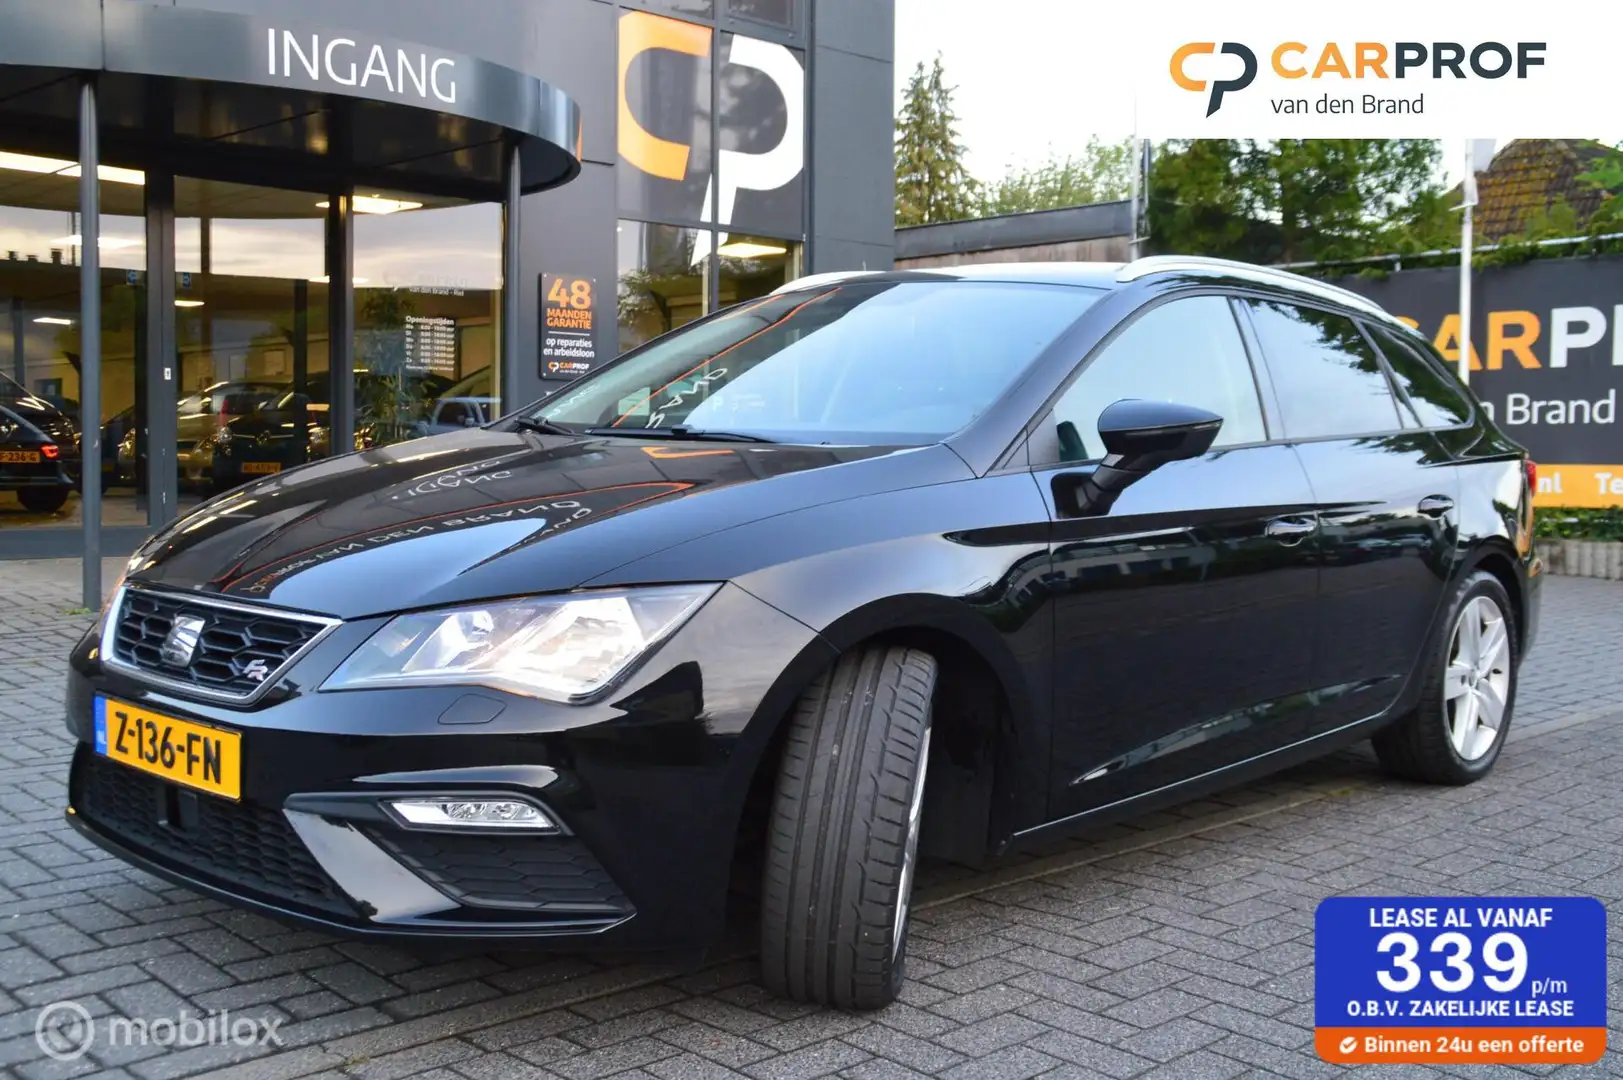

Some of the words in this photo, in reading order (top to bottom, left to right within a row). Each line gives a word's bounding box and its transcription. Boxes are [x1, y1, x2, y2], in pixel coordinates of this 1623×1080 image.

[267, 27, 457, 104] INGANG
[547, 278, 592, 310] 48
[546, 318, 592, 330] GARANTIE
[547, 307, 592, 320] MAANDEN
[543, 347, 553, 356] en
[554, 347, 595, 358] arbeidsloon
[545, 337, 556, 348] op
[557, 338, 593, 348] reparaties
[1396, 304, 1623, 371] ARP
[1506, 388, 1616, 425] Brand
[114, 710, 222, 785] Z-136-FN
